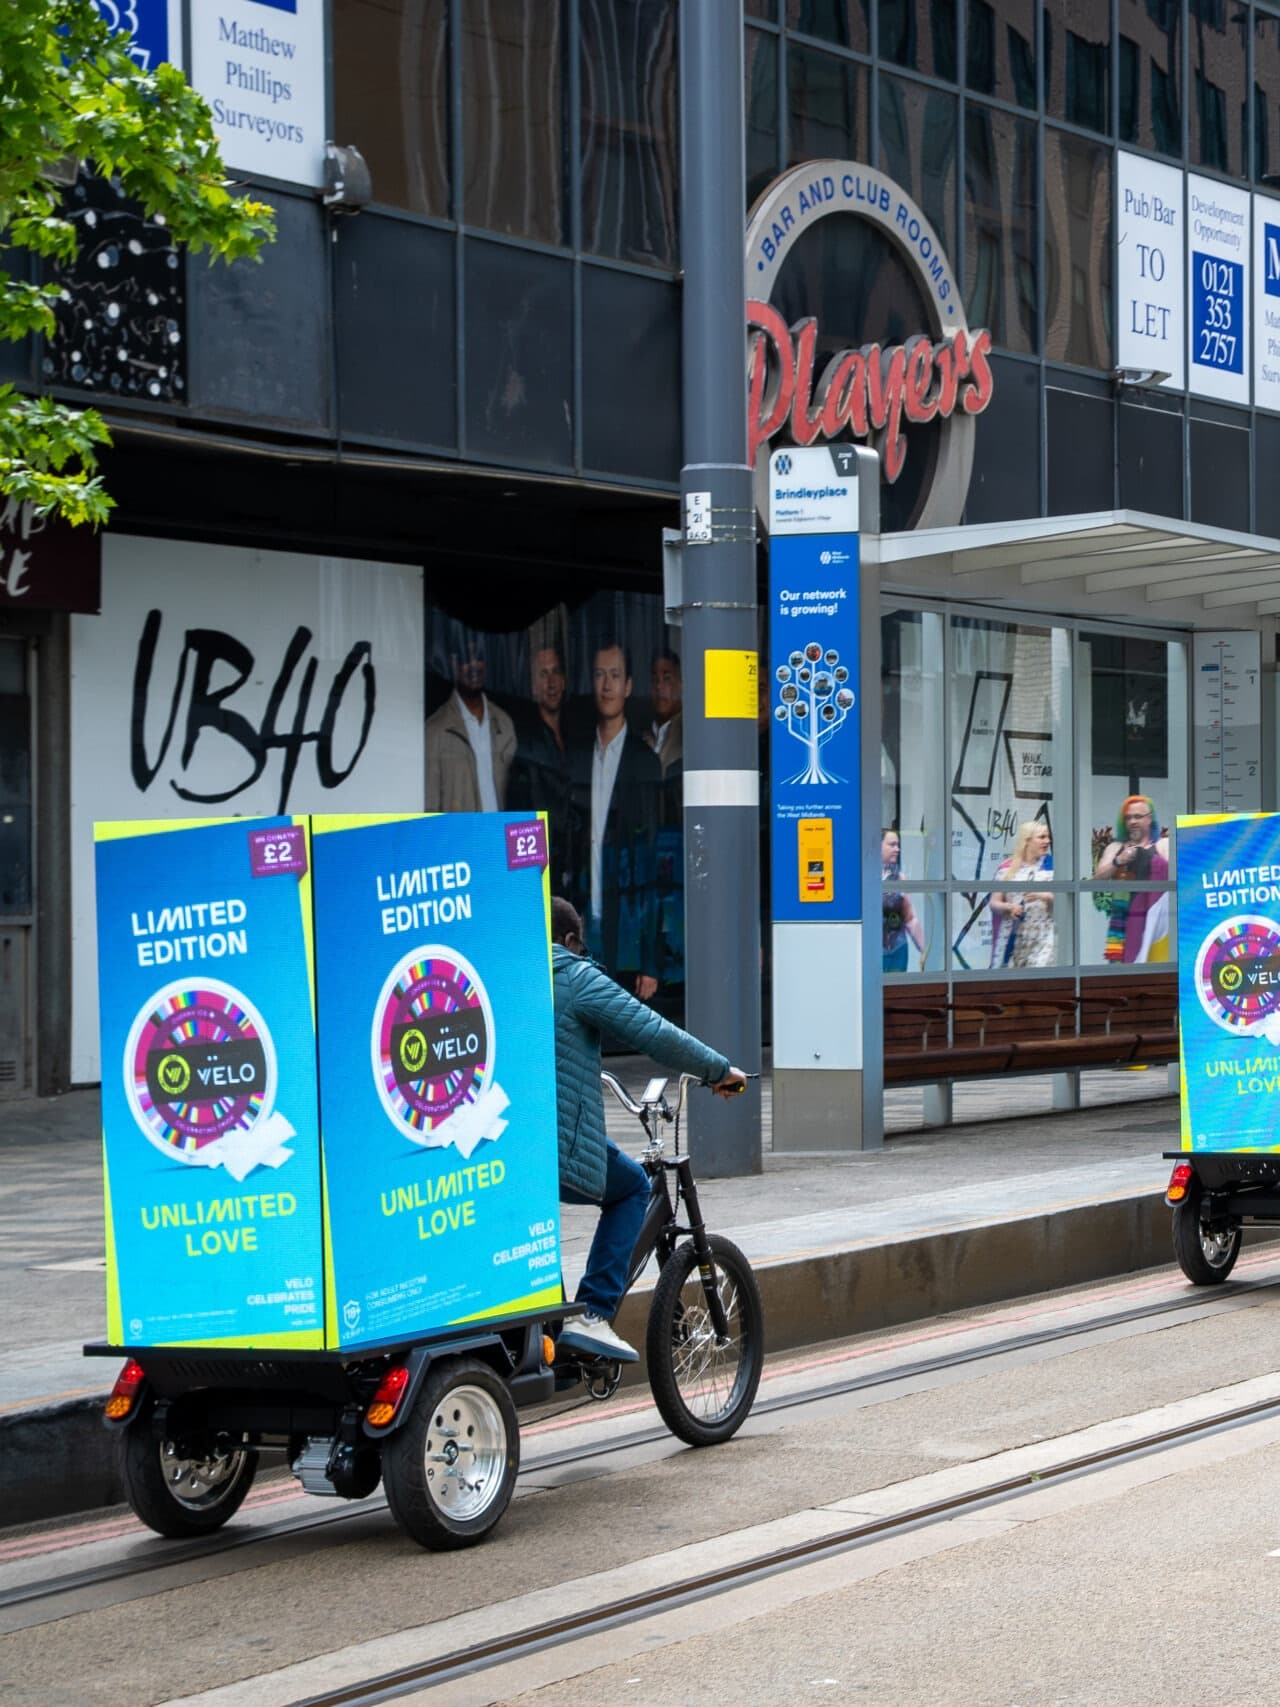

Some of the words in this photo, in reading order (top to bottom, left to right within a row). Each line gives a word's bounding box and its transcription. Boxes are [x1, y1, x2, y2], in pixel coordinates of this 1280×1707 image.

[218, 18, 296, 60] Matthew
[225, 61, 292, 103] Phillips
[213, 99, 304, 144] Surveyors
[1124, 188, 1176, 226] Pub/Bar
[1191, 195, 1244, 226] Development
[761, 206, 796, 263] BAR
[798, 177, 835, 215] AND
[842, 175, 891, 212] CLUB
[896, 204, 951, 301] ROOMS
[1193, 219, 1241, 252] Opportunity
[1137, 244, 1165, 282] TO
[1201, 259, 1234, 297] 0121
[1131, 300, 1171, 340] LET
[1205, 296, 1232, 330] 353
[1200, 329, 1236, 367] 2757
[746, 299, 993, 484] Players
[842, 459, 849, 470] 1
[775, 486, 848, 500] Brindleyplace
[780, 590, 800, 601] Our
[802, 588, 847, 600] network
[780, 605, 789, 616] is
[791, 603, 838, 617] growing!
[1250, 675, 1255, 684] 1
[131, 609, 376, 815] UB40
[1022, 753, 1042, 764] WALK
[1022, 766, 1032, 776] OF
[1249, 766, 1256, 776] 2
[264, 841, 293, 863] £2
[516, 834, 537, 857] £2
[377, 861, 471, 902] LIMITED
[131, 899, 247, 936] LIMITED
[381, 894, 472, 935] EDITION
[137, 930, 248, 966] EDITION
[432, 1032, 479, 1061] VELO
[197, 1062, 255, 1086] VELO
[381, 1159, 506, 1216] UNLIMITED
[141, 1192, 297, 1229] UNLIMITED
[417, 1200, 476, 1240] LOVE
[185, 1227, 258, 1257] LOVE
[528, 1219, 555, 1237] VELO
[493, 1235, 556, 1266] CELEBRATES
[528, 1251, 557, 1270] PRIDE
[247, 1290, 314, 1305] CELEBRATES
[285, 1276, 314, 1289] VELO
[284, 1302, 316, 1315] PRIDE
